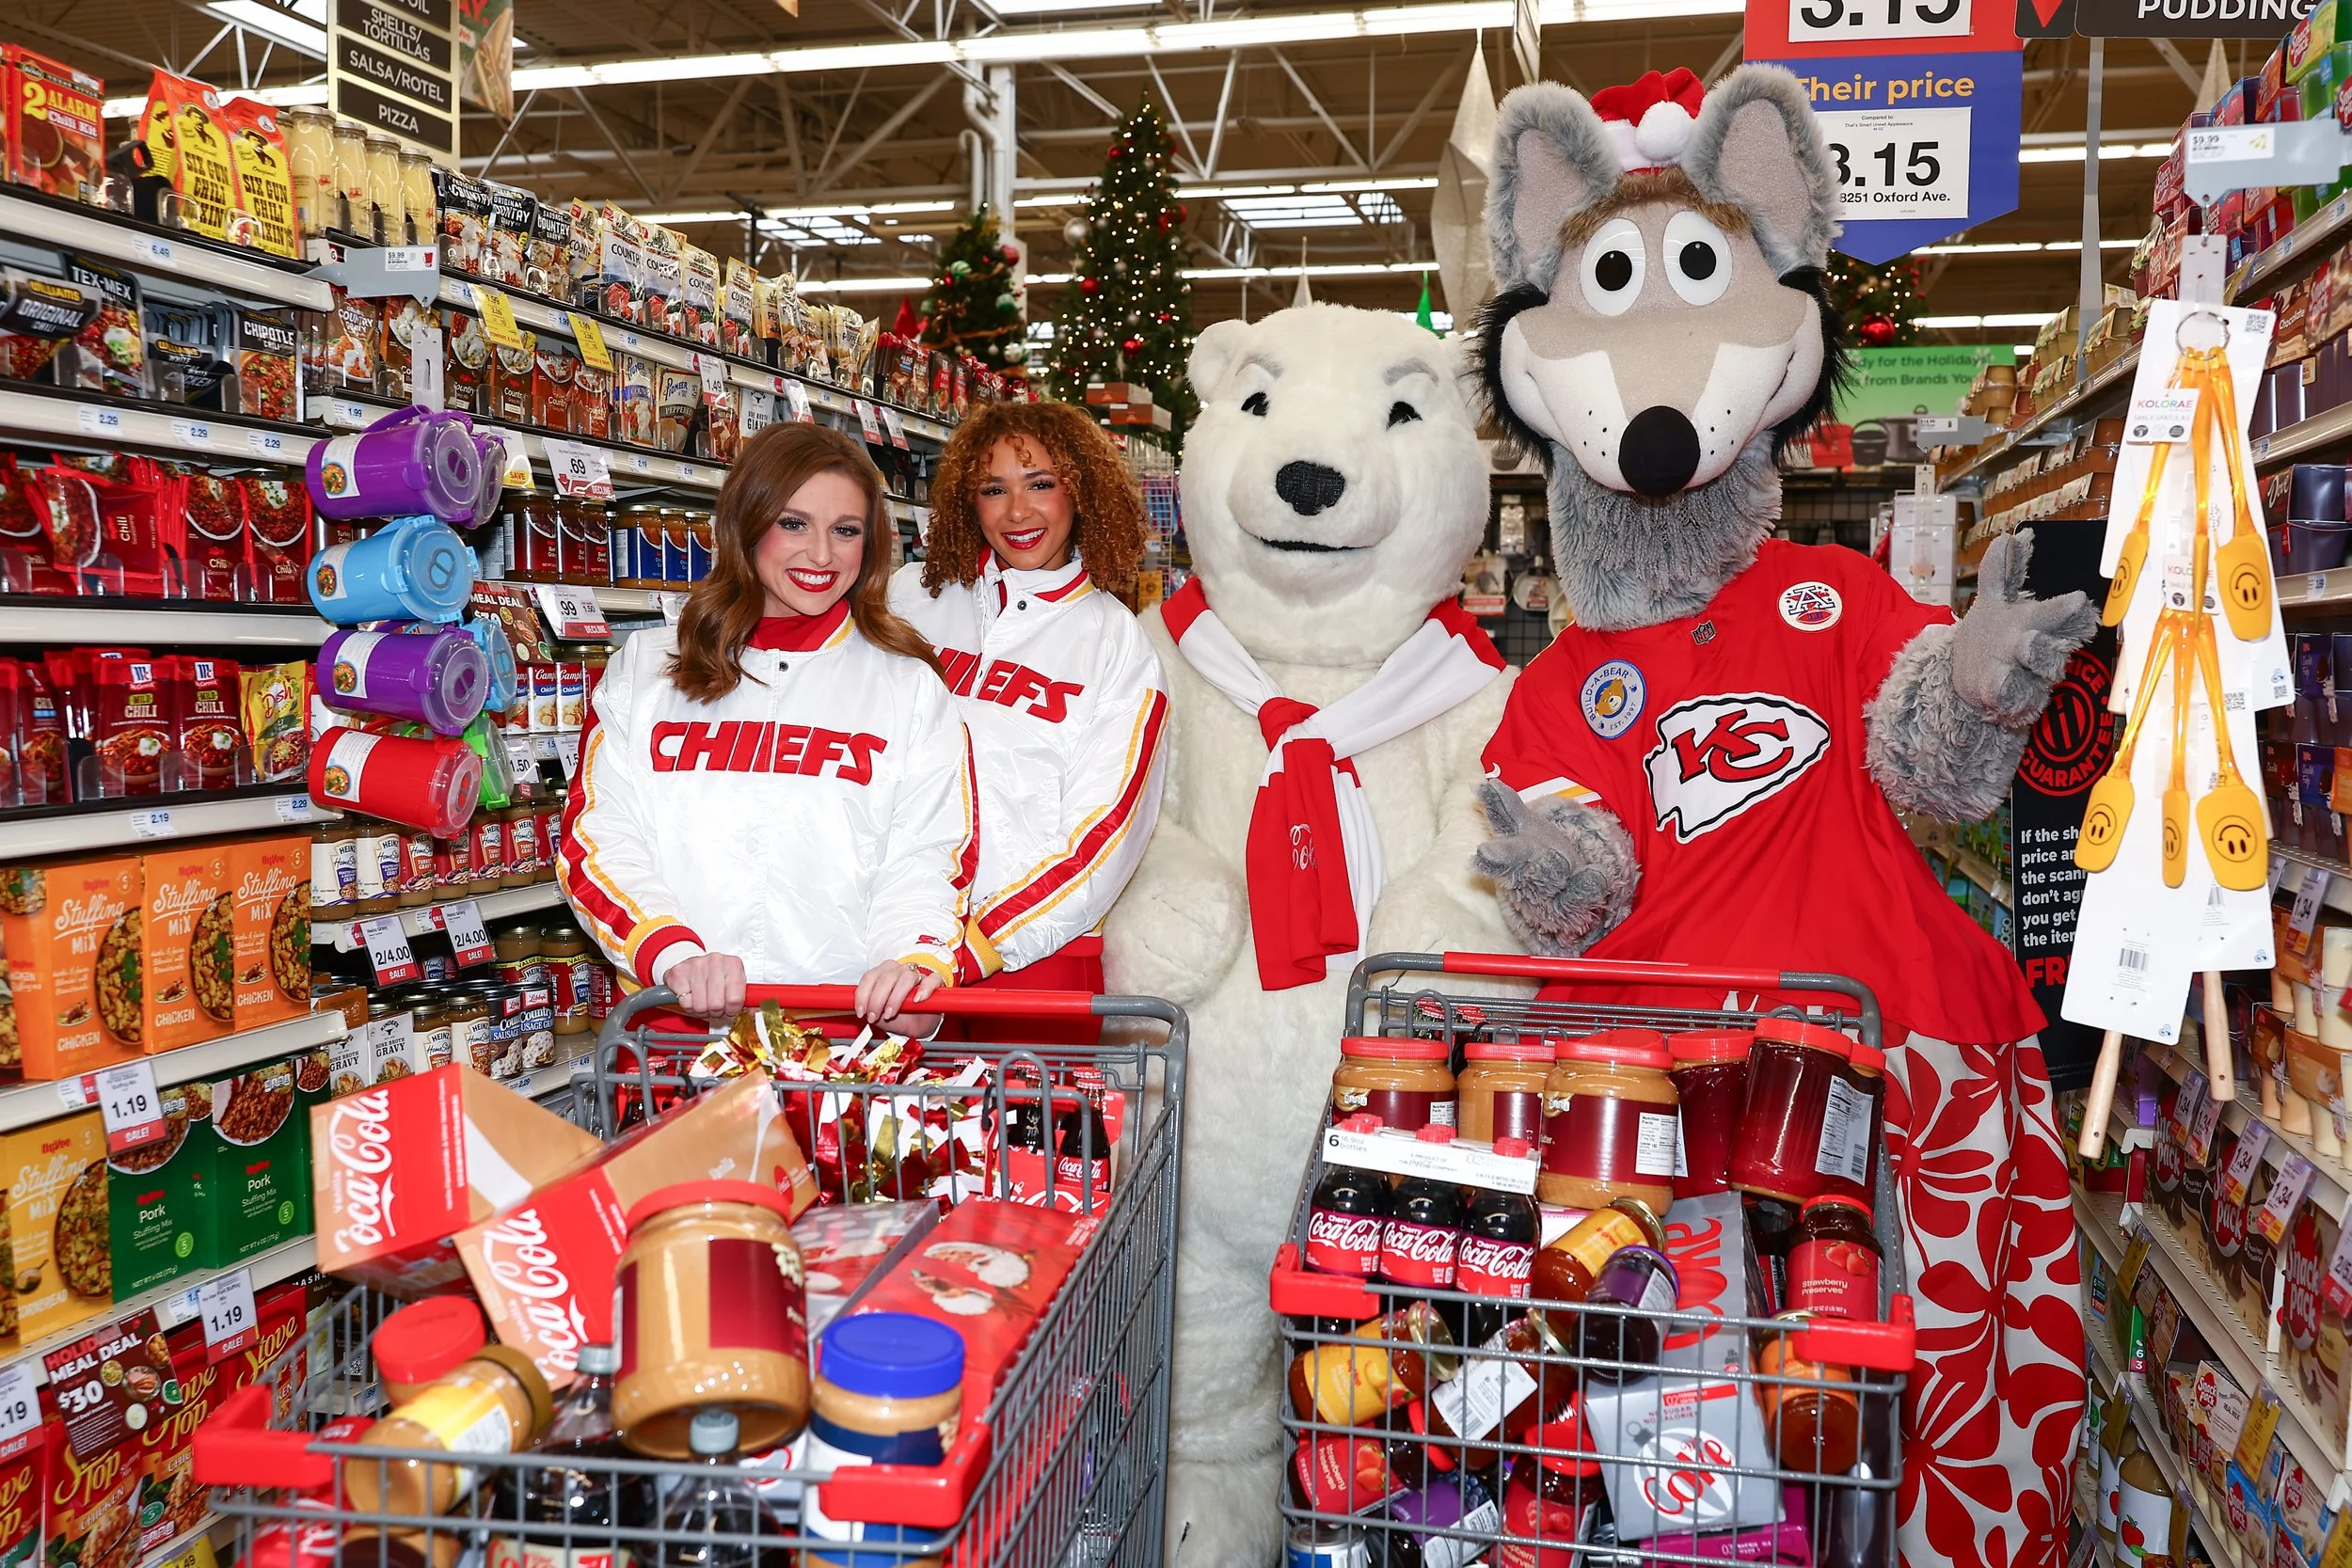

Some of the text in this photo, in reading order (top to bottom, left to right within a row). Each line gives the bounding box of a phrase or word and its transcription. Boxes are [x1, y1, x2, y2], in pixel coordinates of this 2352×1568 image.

[371, 8, 422, 42] SHELLS/
[362, 20, 430, 61] TORTILLAS
[350, 50, 444, 103] SALSA/ROTEL
[1887, 71, 1975, 105] price
[23, 82, 48, 120] 2
[48, 94, 97, 122] ALARM
[49, 112, 76, 129] Chili
[379, 104, 419, 133] PIZZA
[185, 152, 206, 174] SIX
[208, 159, 229, 185] GUN
[194, 179, 226, 205] CHILI
[243, 174, 288, 205] SIX GUN
[1873, 191, 1918, 203] Oxford
[1921, 191, 1950, 202] Ave.
[254, 198, 284, 224] CHILI
[537, 214, 570, 237] COUNTRY
[151, 245, 170, 259] 6.49
[388, 251, 405, 260] $9.99
[72, 266, 132, 298] TEX-MEX
[29, 280, 81, 302] WILLIAMS
[18, 299, 84, 328] ORIGINAL
[244, 321, 295, 346] CHIPOTLE
[1878, 356, 1898, 368] for
[1901, 356, 1922, 367] the
[707, 378, 722, 392] 1.49
[1865, 374, 1897, 386] from
[1901, 373, 1942, 386] Brands
[665, 404, 693, 417] PEPPERED
[2137, 400, 2193, 408] KOLORAE
[99, 413, 119, 426] 2.29
[348, 407, 362, 418] 1.99
[191, 427, 207, 438] 2.29
[265, 438, 280, 450] 2.29
[510, 471, 526, 482] SAVE
[116, 516, 127, 542] Chili
[470, 593, 523, 608] MEAL DEAL
[584, 624, 608, 634] DECLINE
[1697, 628, 1713, 641] NFL
[931, 645, 1085, 723] HIEFS
[124, 705, 157, 718] CHILI
[195, 701, 225, 714] CHILI
[510, 759, 531, 772] 1.50
[292, 800, 308, 809] 2.29
[151, 813, 169, 824] 2.19
[518, 820, 534, 830] HEINZ
[383, 838, 399, 848] HEINZ
[2021, 831, 2033, 844] If
[2035, 829, 2059, 843] the
[2022, 850, 2058, 867] price
[237, 868, 297, 900] Stuffing
[2022, 872, 2046, 885] the
[153, 876, 217, 912] Stuffing
[2023, 890, 2059, 906] don't
[54, 894, 125, 928] Stuffing
[2023, 909, 2076, 929] you get
[454, 929, 485, 947] 2/4.00
[2024, 933, 2047, 947] the
[376, 945, 410, 965] 2/4.00
[468, 950, 483, 960] SALE!
[389, 968, 405, 979] SALE!
[237, 990, 273, 1006] CHICKEN
[155, 1008, 195, 1027] CHICKEN
[472, 1022, 489, 1032] HEINZ
[57, 1031, 101, 1052] CHICKEN
[431, 1032, 450, 1042] HEINZ
[376, 1042, 405, 1057] GRAVY
[330, 1056, 359, 1071] GRAVY
[580, 1056, 590, 1065] 4.49
[518, 1078, 531, 1088] 2.29
[112, 1095, 148, 1118] 1.19
[124, 1127, 150, 1143] SALE!
[1328, 1134, 1340, 1148] 6
[2234, 1147, 2252, 1173] 1.34
[247, 1174, 271, 1192] Pork
[242, 1188, 277, 1207] Stuffing Mix
[2274, 1182, 2293, 1209] 1.34
[139, 1204, 166, 1223] Pork
[1327, 1215, 1352, 1226] Cherry
[133, 1219, 173, 1240] Stuffing Mix
[1399, 1225, 1422, 1235] Cherry
[1476, 1240, 1500, 1250] Cherry
[1803, 1277, 1849, 1290] Strawberry
[1803, 1286, 1844, 1295] Preserves
[212, 1306, 243, 1333] 1.19
[222, 1336, 243, 1354] SALE!
[49, 1333, 143, 1384] MEAL DEAL
[2136, 1349, 2144, 1358] 6
[2136, 1360, 2143, 1370] 3
[2197, 1376, 2217, 1396] Snack
[58, 1380, 104, 1413] $30
[1327, 1443, 1347, 1492] Strawberry
